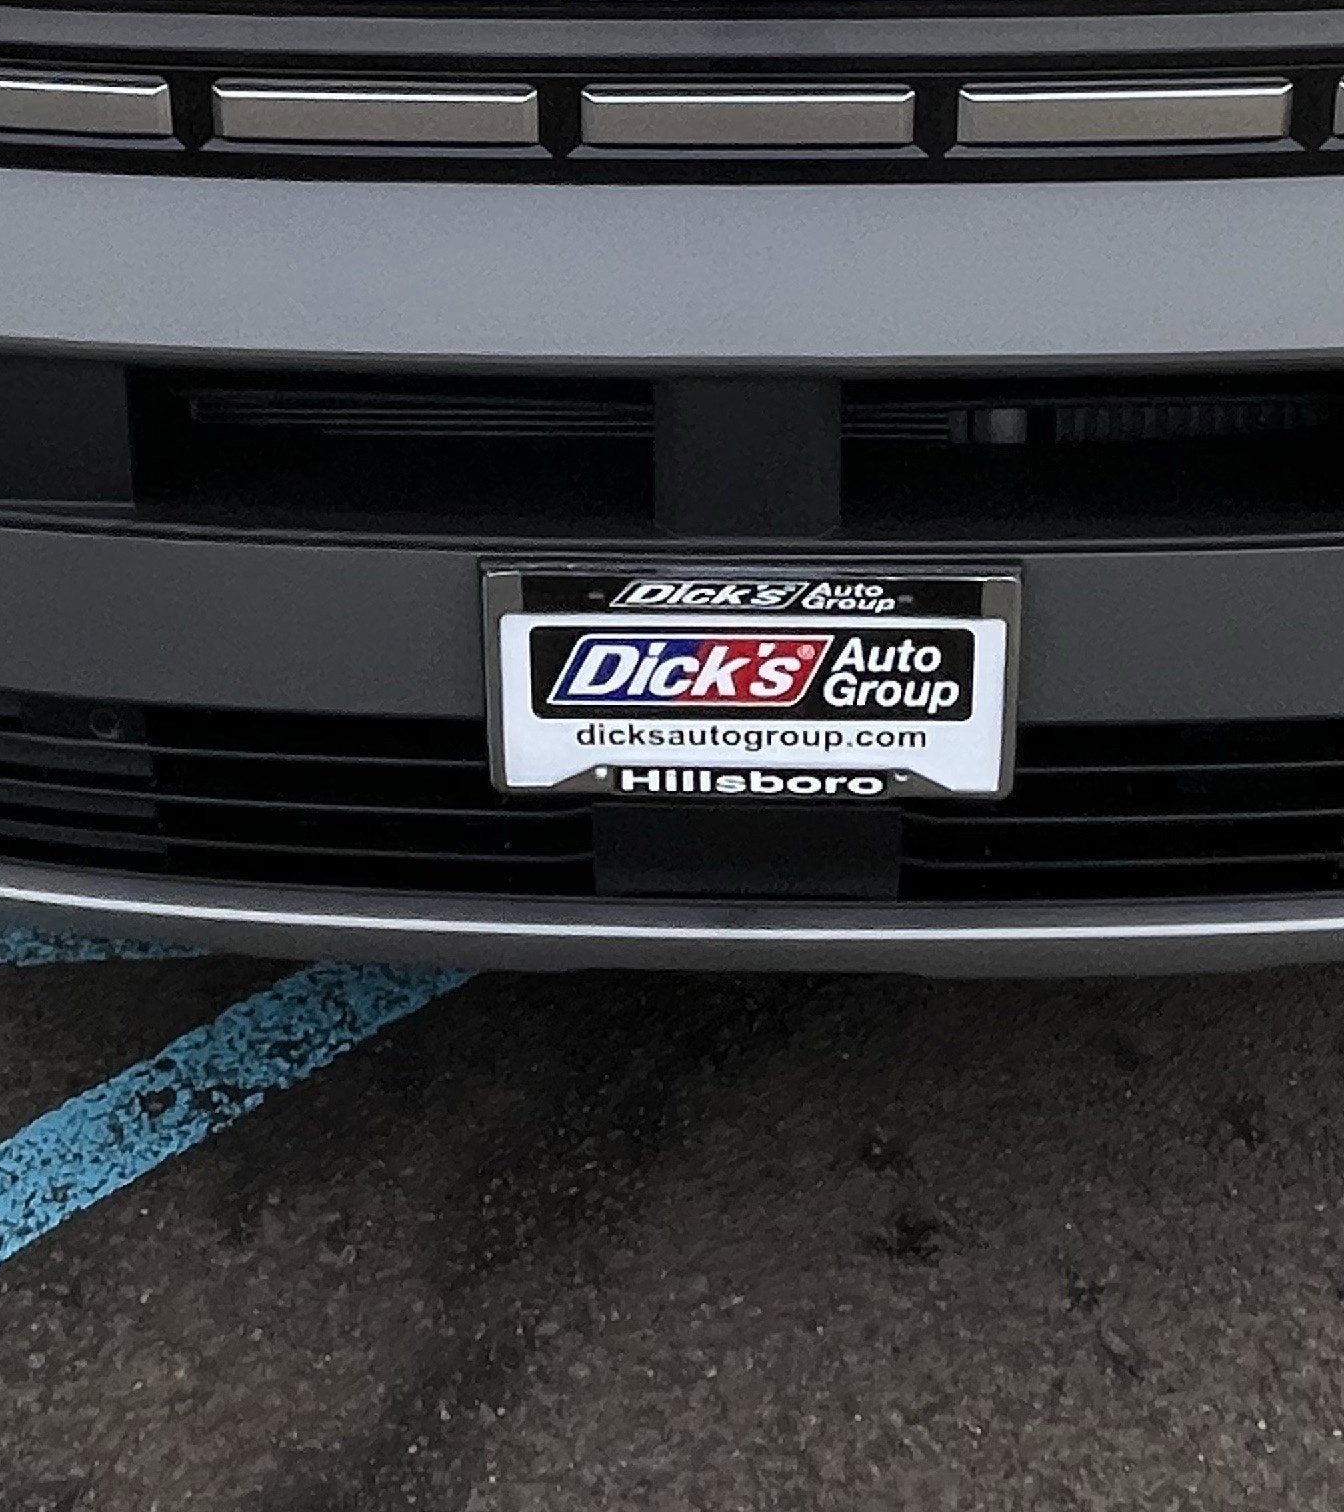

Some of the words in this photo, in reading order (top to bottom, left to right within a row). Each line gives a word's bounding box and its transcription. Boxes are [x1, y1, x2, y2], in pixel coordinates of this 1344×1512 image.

[627, 580, 790, 606] Dick's
[803, 581, 884, 597] Auto
[802, 594, 896, 614] Group
[567, 641, 801, 698] Dick's
[831, 638, 942, 673] Auto
[822, 672, 960, 714] Group
[575, 722, 927, 752] dicksautogroup.com
[620, 768, 884, 795] Hillsboro
